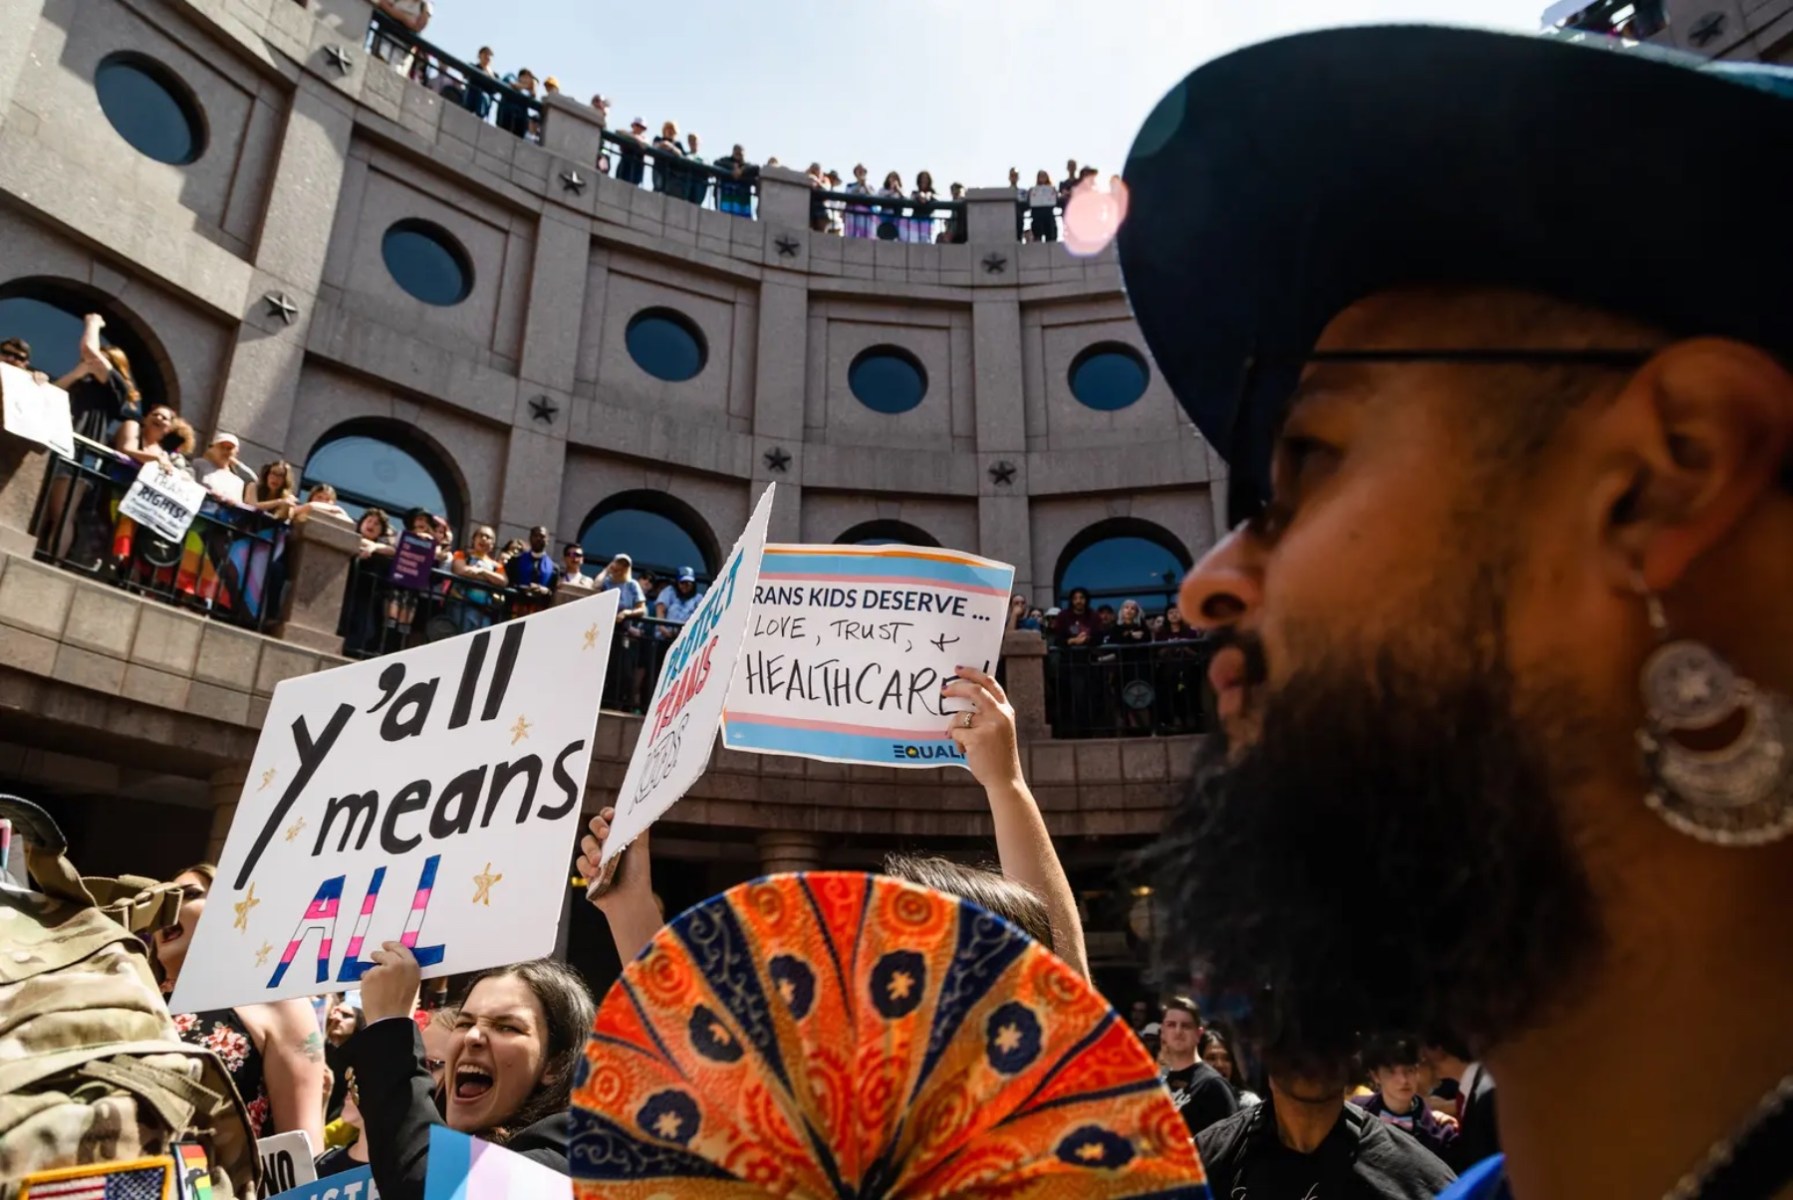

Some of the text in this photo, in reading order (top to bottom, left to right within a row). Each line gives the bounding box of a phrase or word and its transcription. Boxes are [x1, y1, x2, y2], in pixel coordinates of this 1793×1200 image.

[137, 485, 187, 522] RIGHTS!
[659, 547, 744, 698] PROTECT
[753, 586, 804, 606] RANS
[809, 587, 857, 609] KIDS
[862, 590, 968, 617] DESERVE
[648, 634, 719, 748] TRANS
[311, 739, 586, 856] means
[266, 854, 447, 989] ALL
